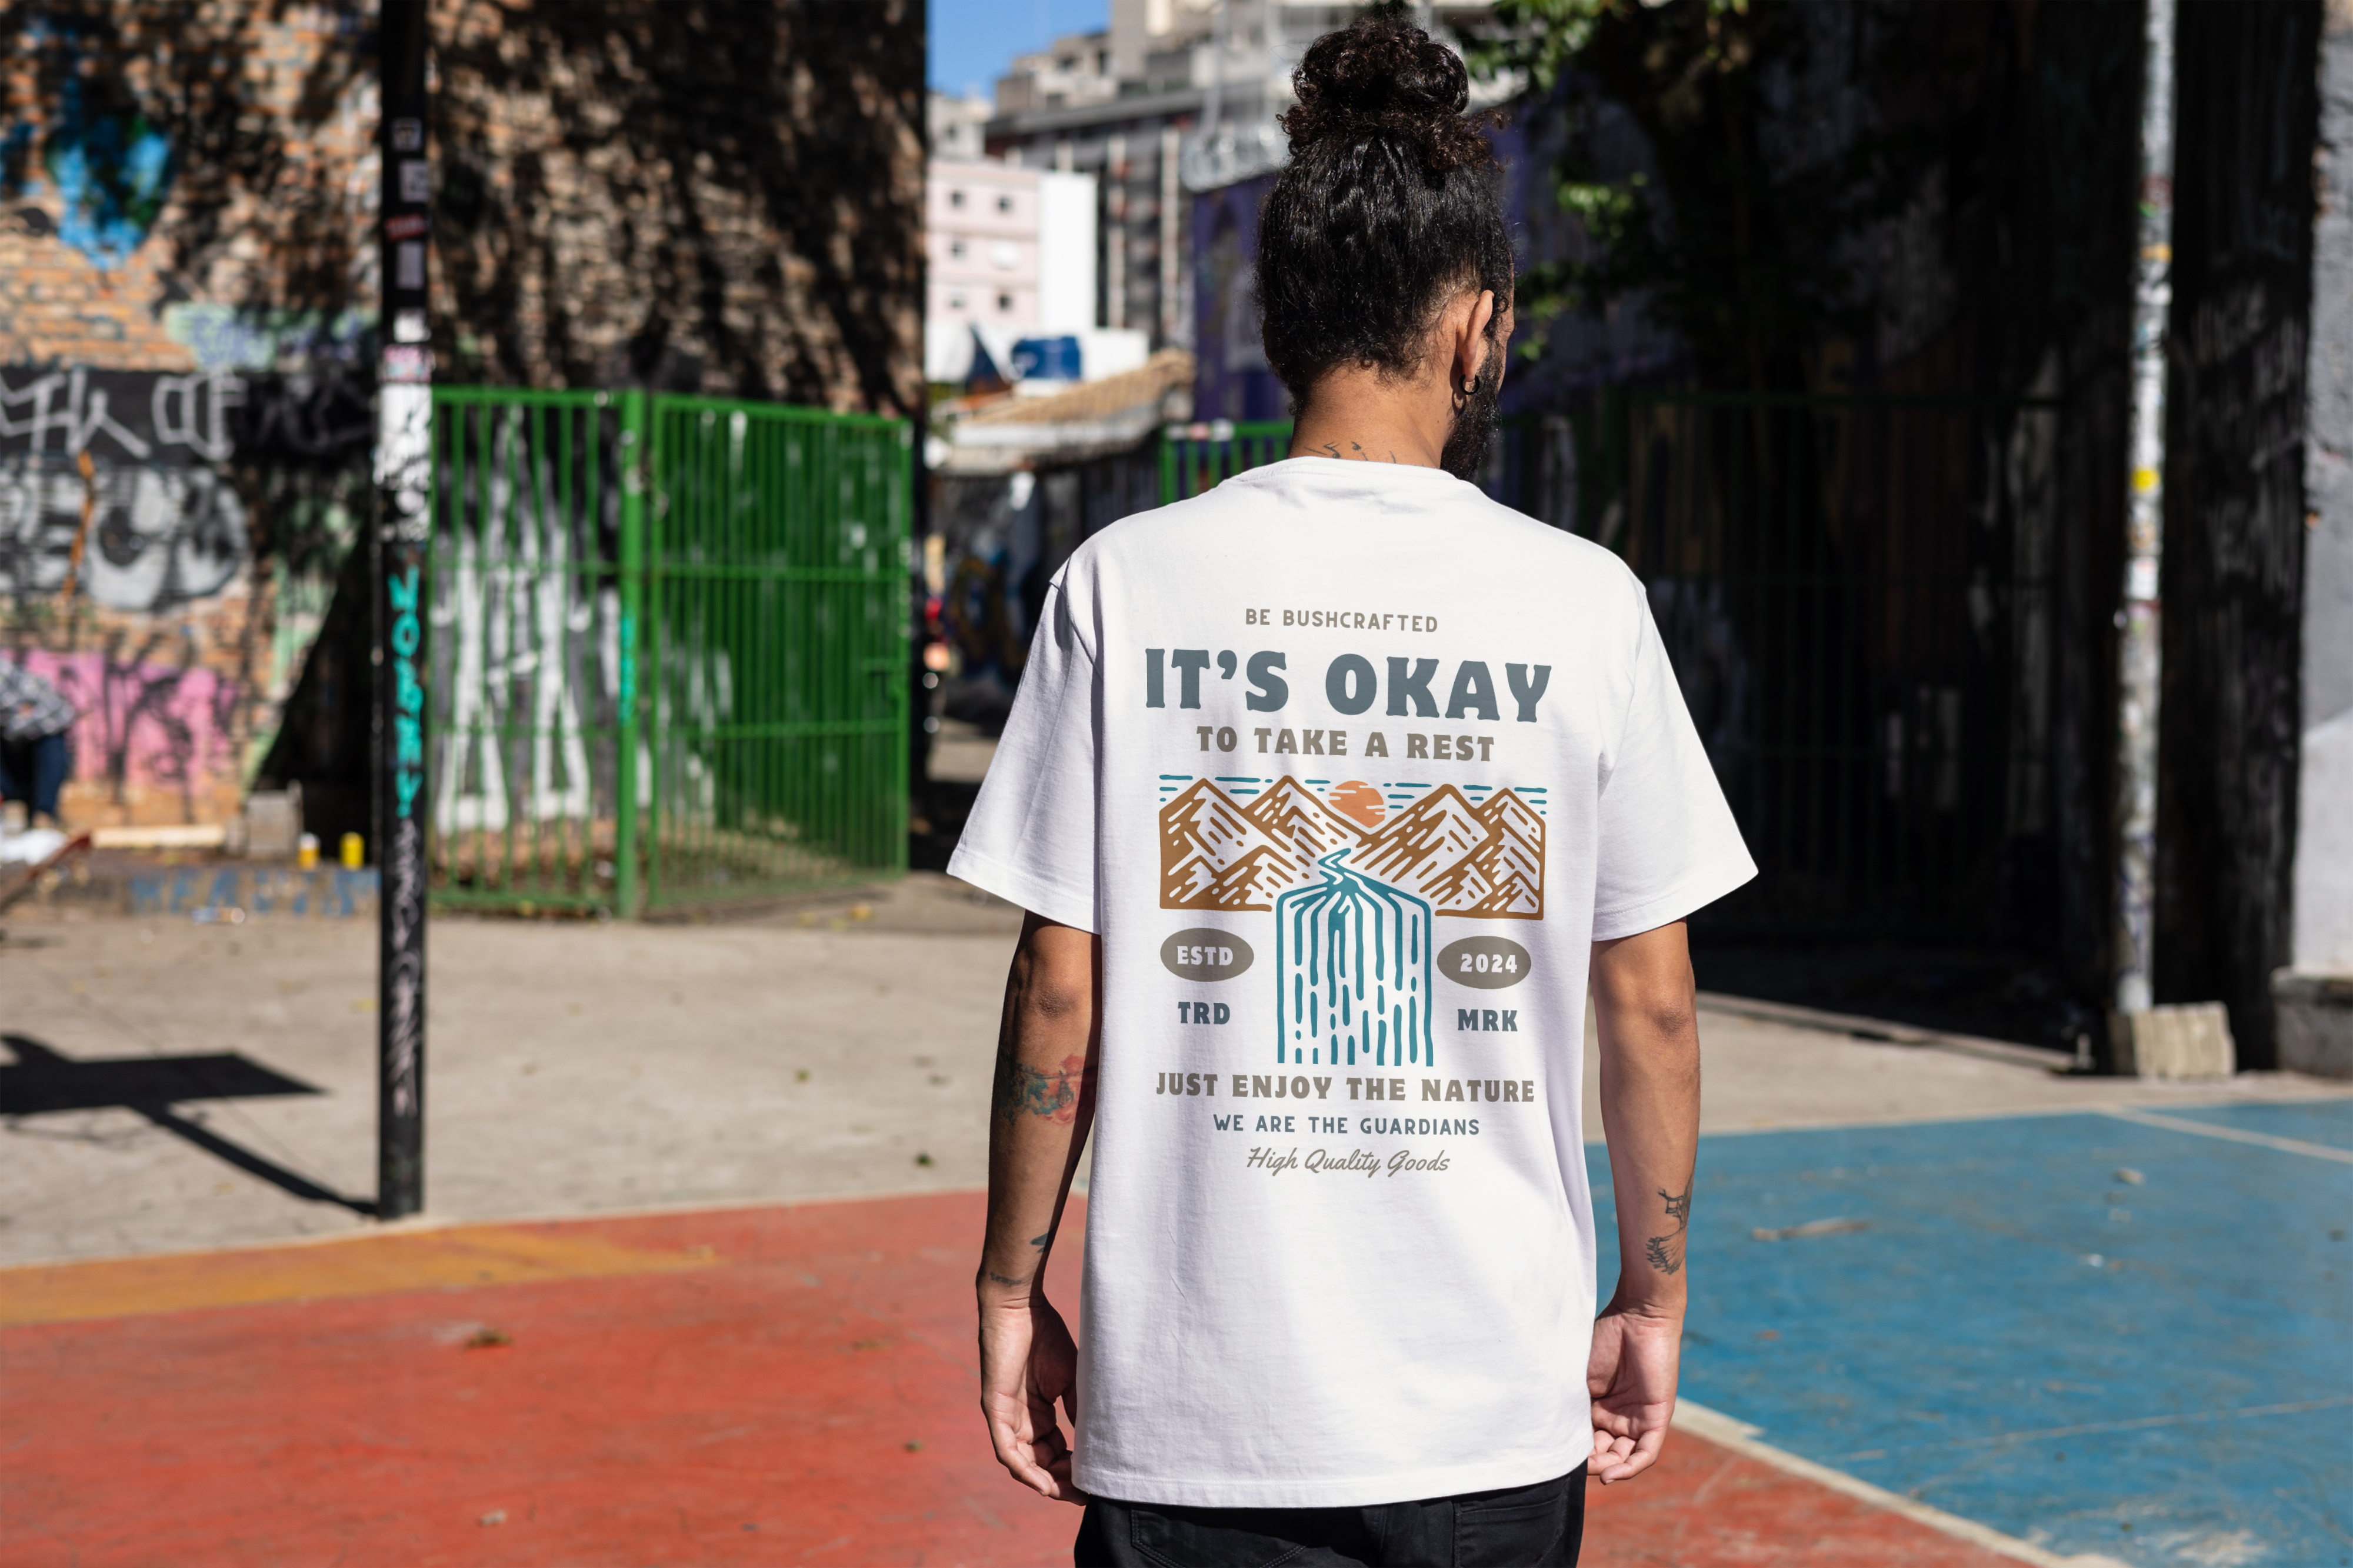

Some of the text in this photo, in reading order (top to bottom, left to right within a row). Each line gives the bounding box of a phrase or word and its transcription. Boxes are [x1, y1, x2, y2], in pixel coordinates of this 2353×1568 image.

[1245, 608, 1438, 633] BE BUSHCRAFTED
[1145, 648, 1552, 723] IT'S OKAY
[1196, 725, 1495, 762] TO TAKE A REST
[1176, 945, 1234, 966] ESTD
[1459, 953, 1518, 973] 2024
[1177, 1002, 1231, 1025] TRD
[1457, 1009, 1518, 1032] MRK
[1156, 1072, 1535, 1103] JUST ENJOY THE NATURE
[1212, 1113, 1479, 1136] WE ARE THE GUARDIANS
[1247, 1146, 1451, 1179] High Quality Goods
